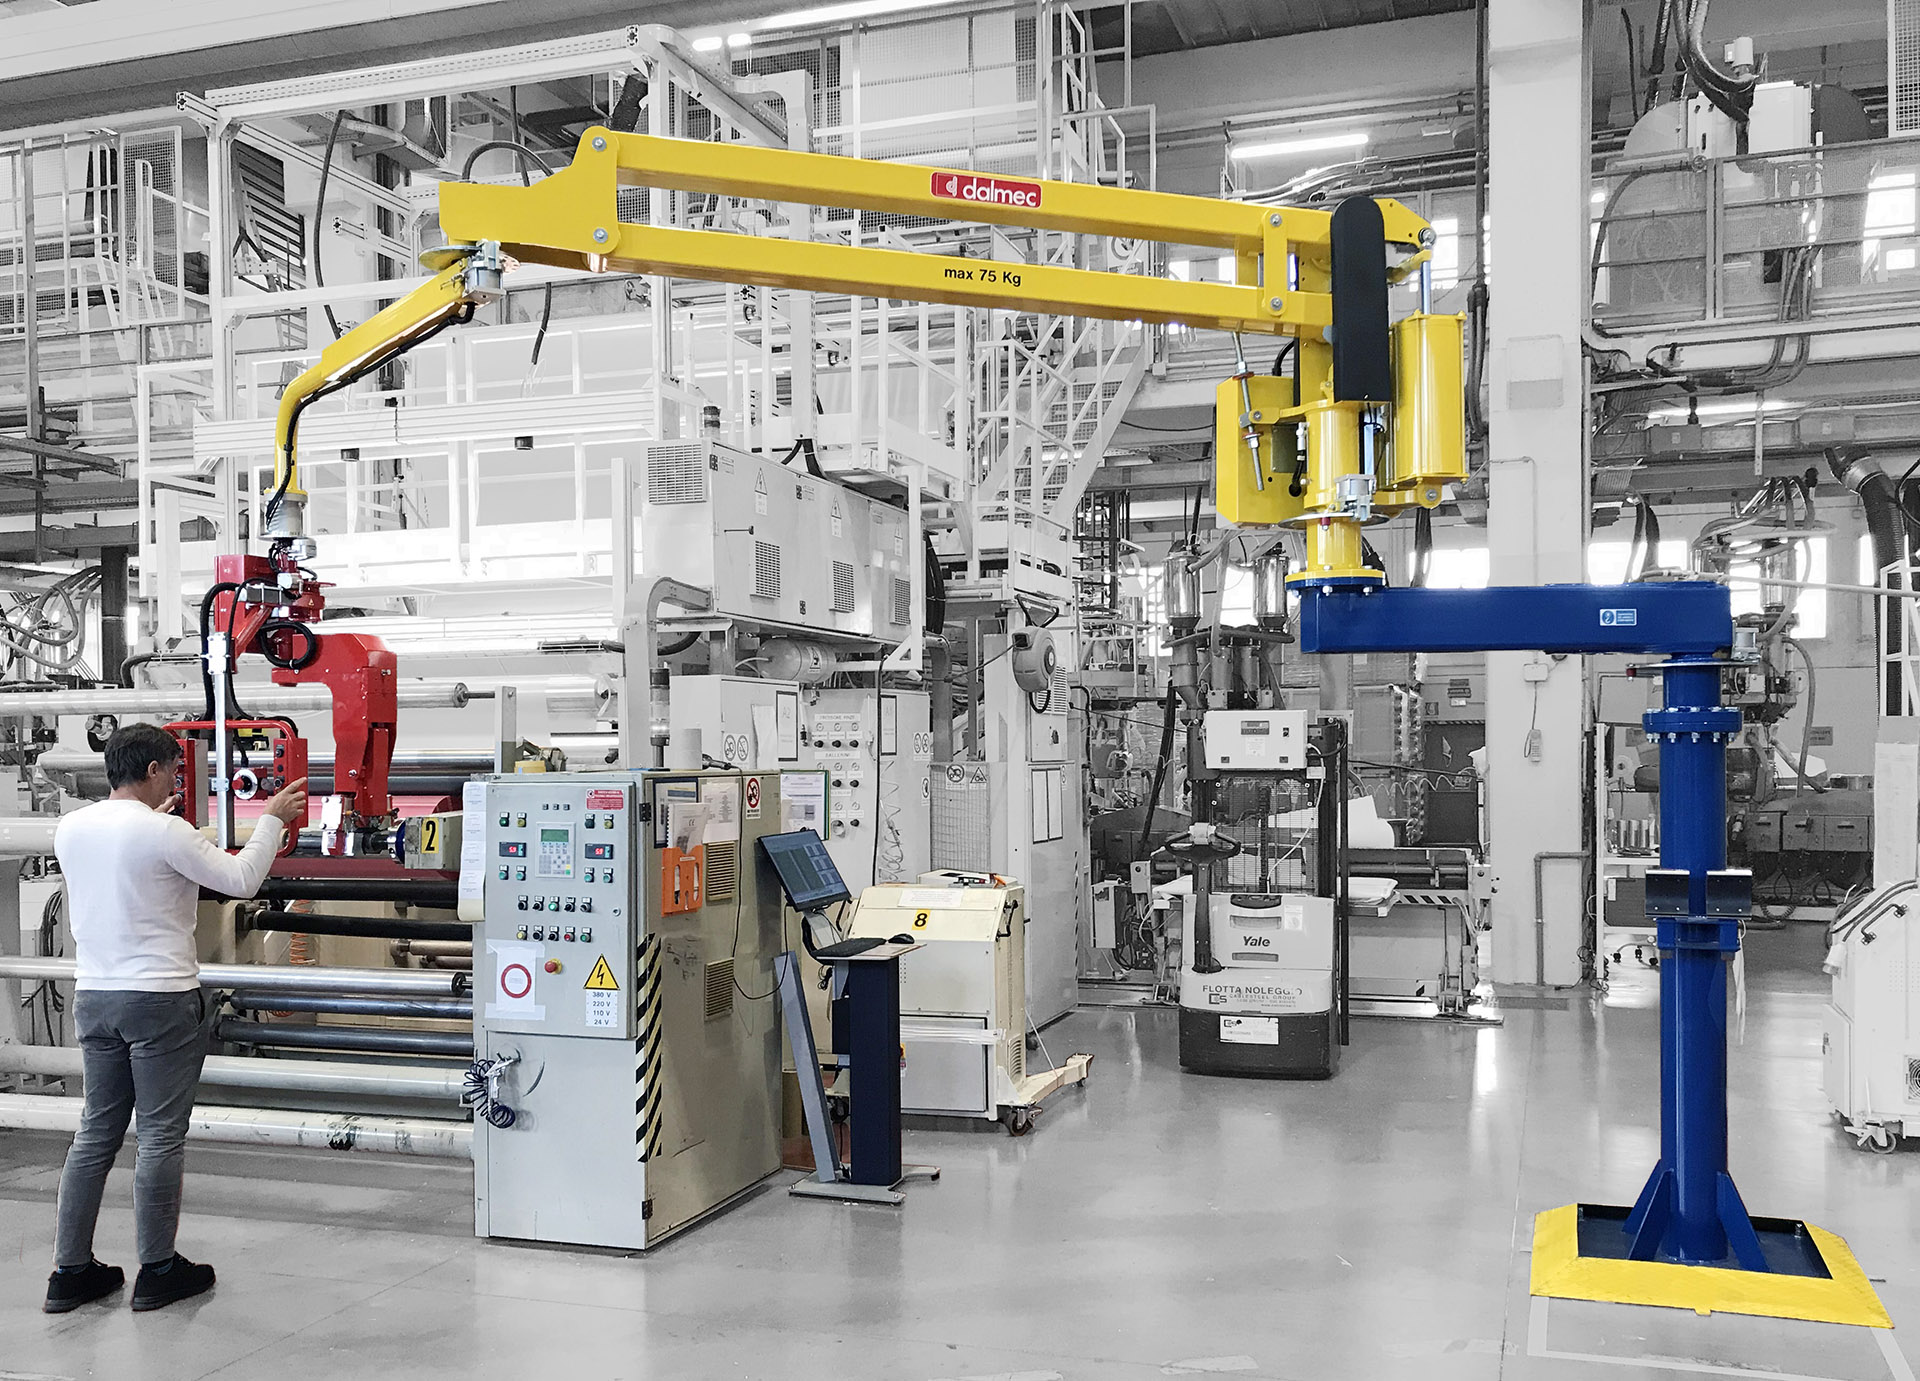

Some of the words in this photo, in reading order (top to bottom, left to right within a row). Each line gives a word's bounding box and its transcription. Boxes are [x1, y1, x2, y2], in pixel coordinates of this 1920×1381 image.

[963, 178, 1037, 207] dalmec
[945, 268, 973, 281] max
[980, 269, 997, 283] 75
[1003, 271, 1022, 288] Kg
[425, 820, 436, 851] 2
[914, 912, 928, 927] 8
[1243, 935, 1271, 947] Yale
[1202, 985, 1242, 993] FLOTTA
